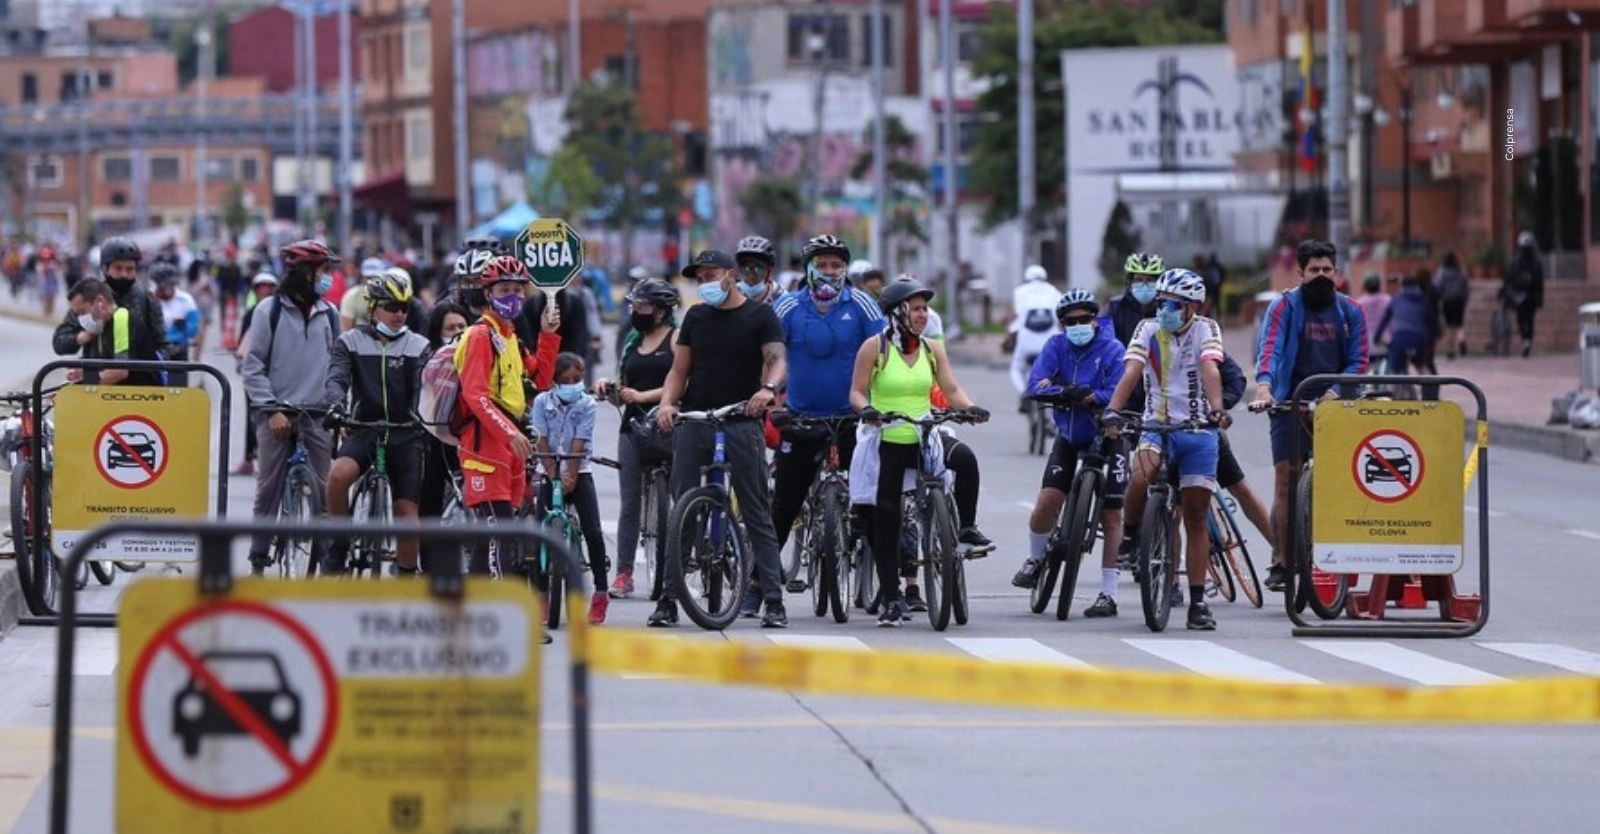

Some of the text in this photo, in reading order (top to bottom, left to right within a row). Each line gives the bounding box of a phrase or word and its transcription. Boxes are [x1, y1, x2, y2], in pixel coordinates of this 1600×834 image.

[1088, 109, 1147, 133] SAN
[525, 241, 574, 268] SIGA
[129, 506, 176, 515] EXCLUSIVO
[1387, 519, 1432, 528] EXCLUSIVO
[346, 646, 510, 673] EXCLUSIVO
